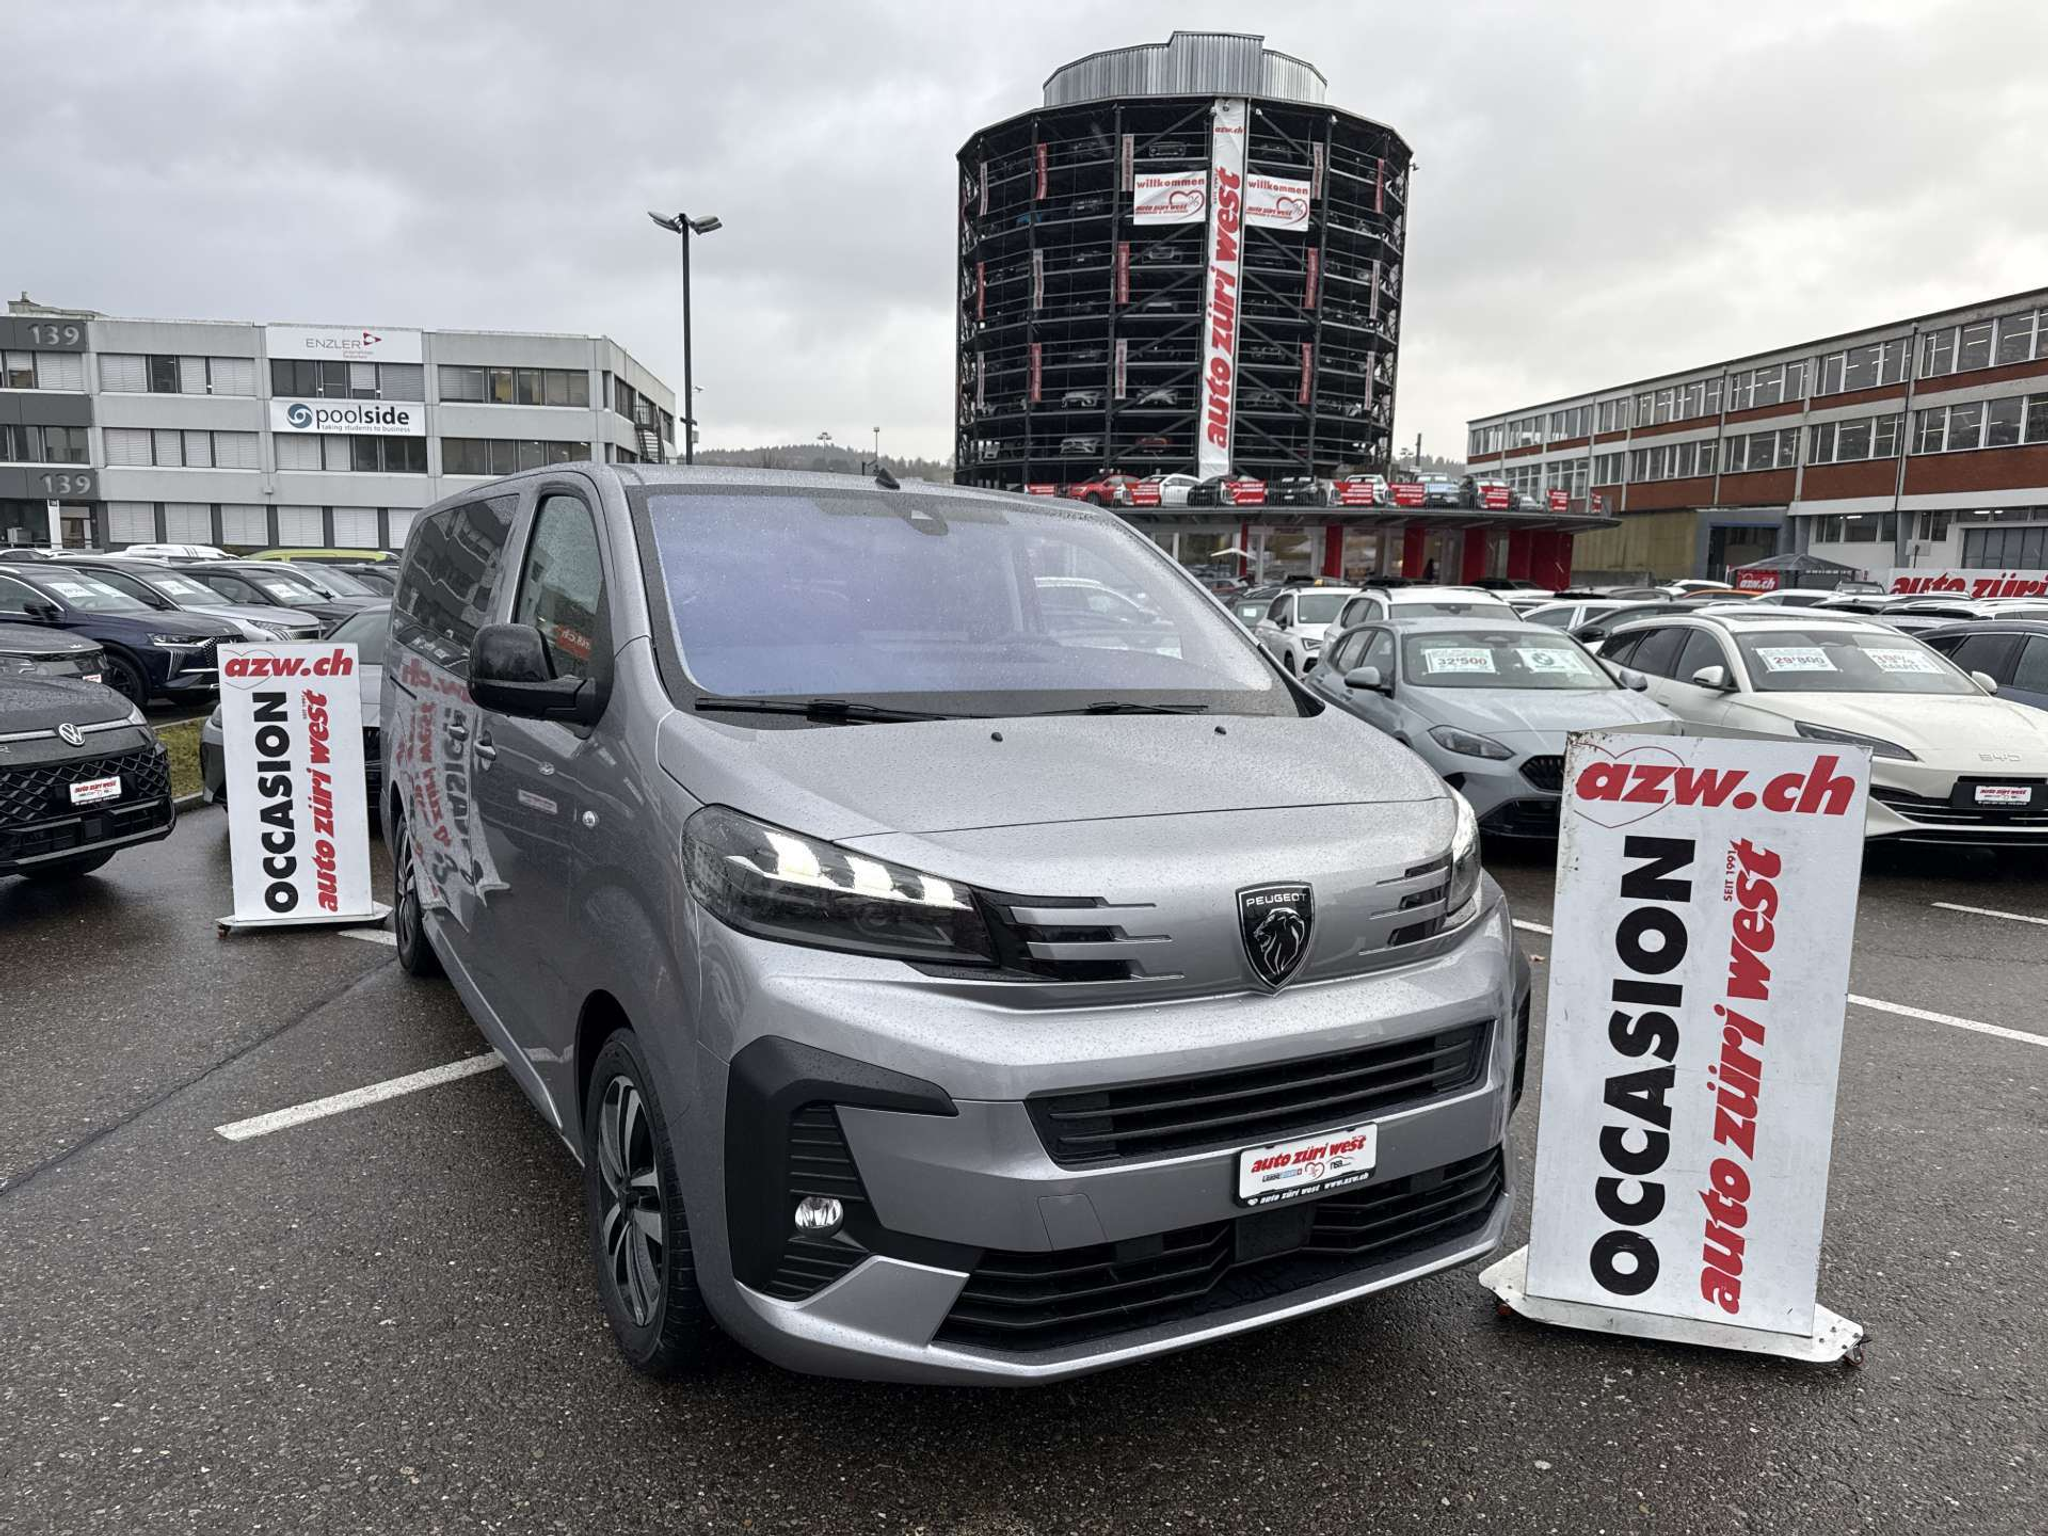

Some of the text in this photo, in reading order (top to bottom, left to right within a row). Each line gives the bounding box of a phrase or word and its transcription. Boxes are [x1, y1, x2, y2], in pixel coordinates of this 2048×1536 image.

[1137, 178, 1205, 189] willkommen
[1247, 179, 1309, 195] willkommen
[1205, 166, 1240, 449] auto züri west
[28, 323, 80, 346] 139
[305, 338, 361, 350] ENZLER
[316, 405, 410, 429] poolside
[40, 473, 91, 494] 139
[224, 649, 353, 677] azw.ch
[302, 689, 338, 913] auto züri west
[1575, 755, 1856, 816] azw.ch
[252, 691, 299, 913] OCCASION
[1723, 850, 1736, 902] SEIT 1991
[1246, 893, 1307, 907] PEUGEOT
[1589, 834, 1697, 1297] OCCASION
[1699, 837, 1782, 1316] auto züri west
[1251, 1136, 1367, 1173] auto züri west
[1260, 1172, 1369, 1204] auto züri west www.azw.ch
